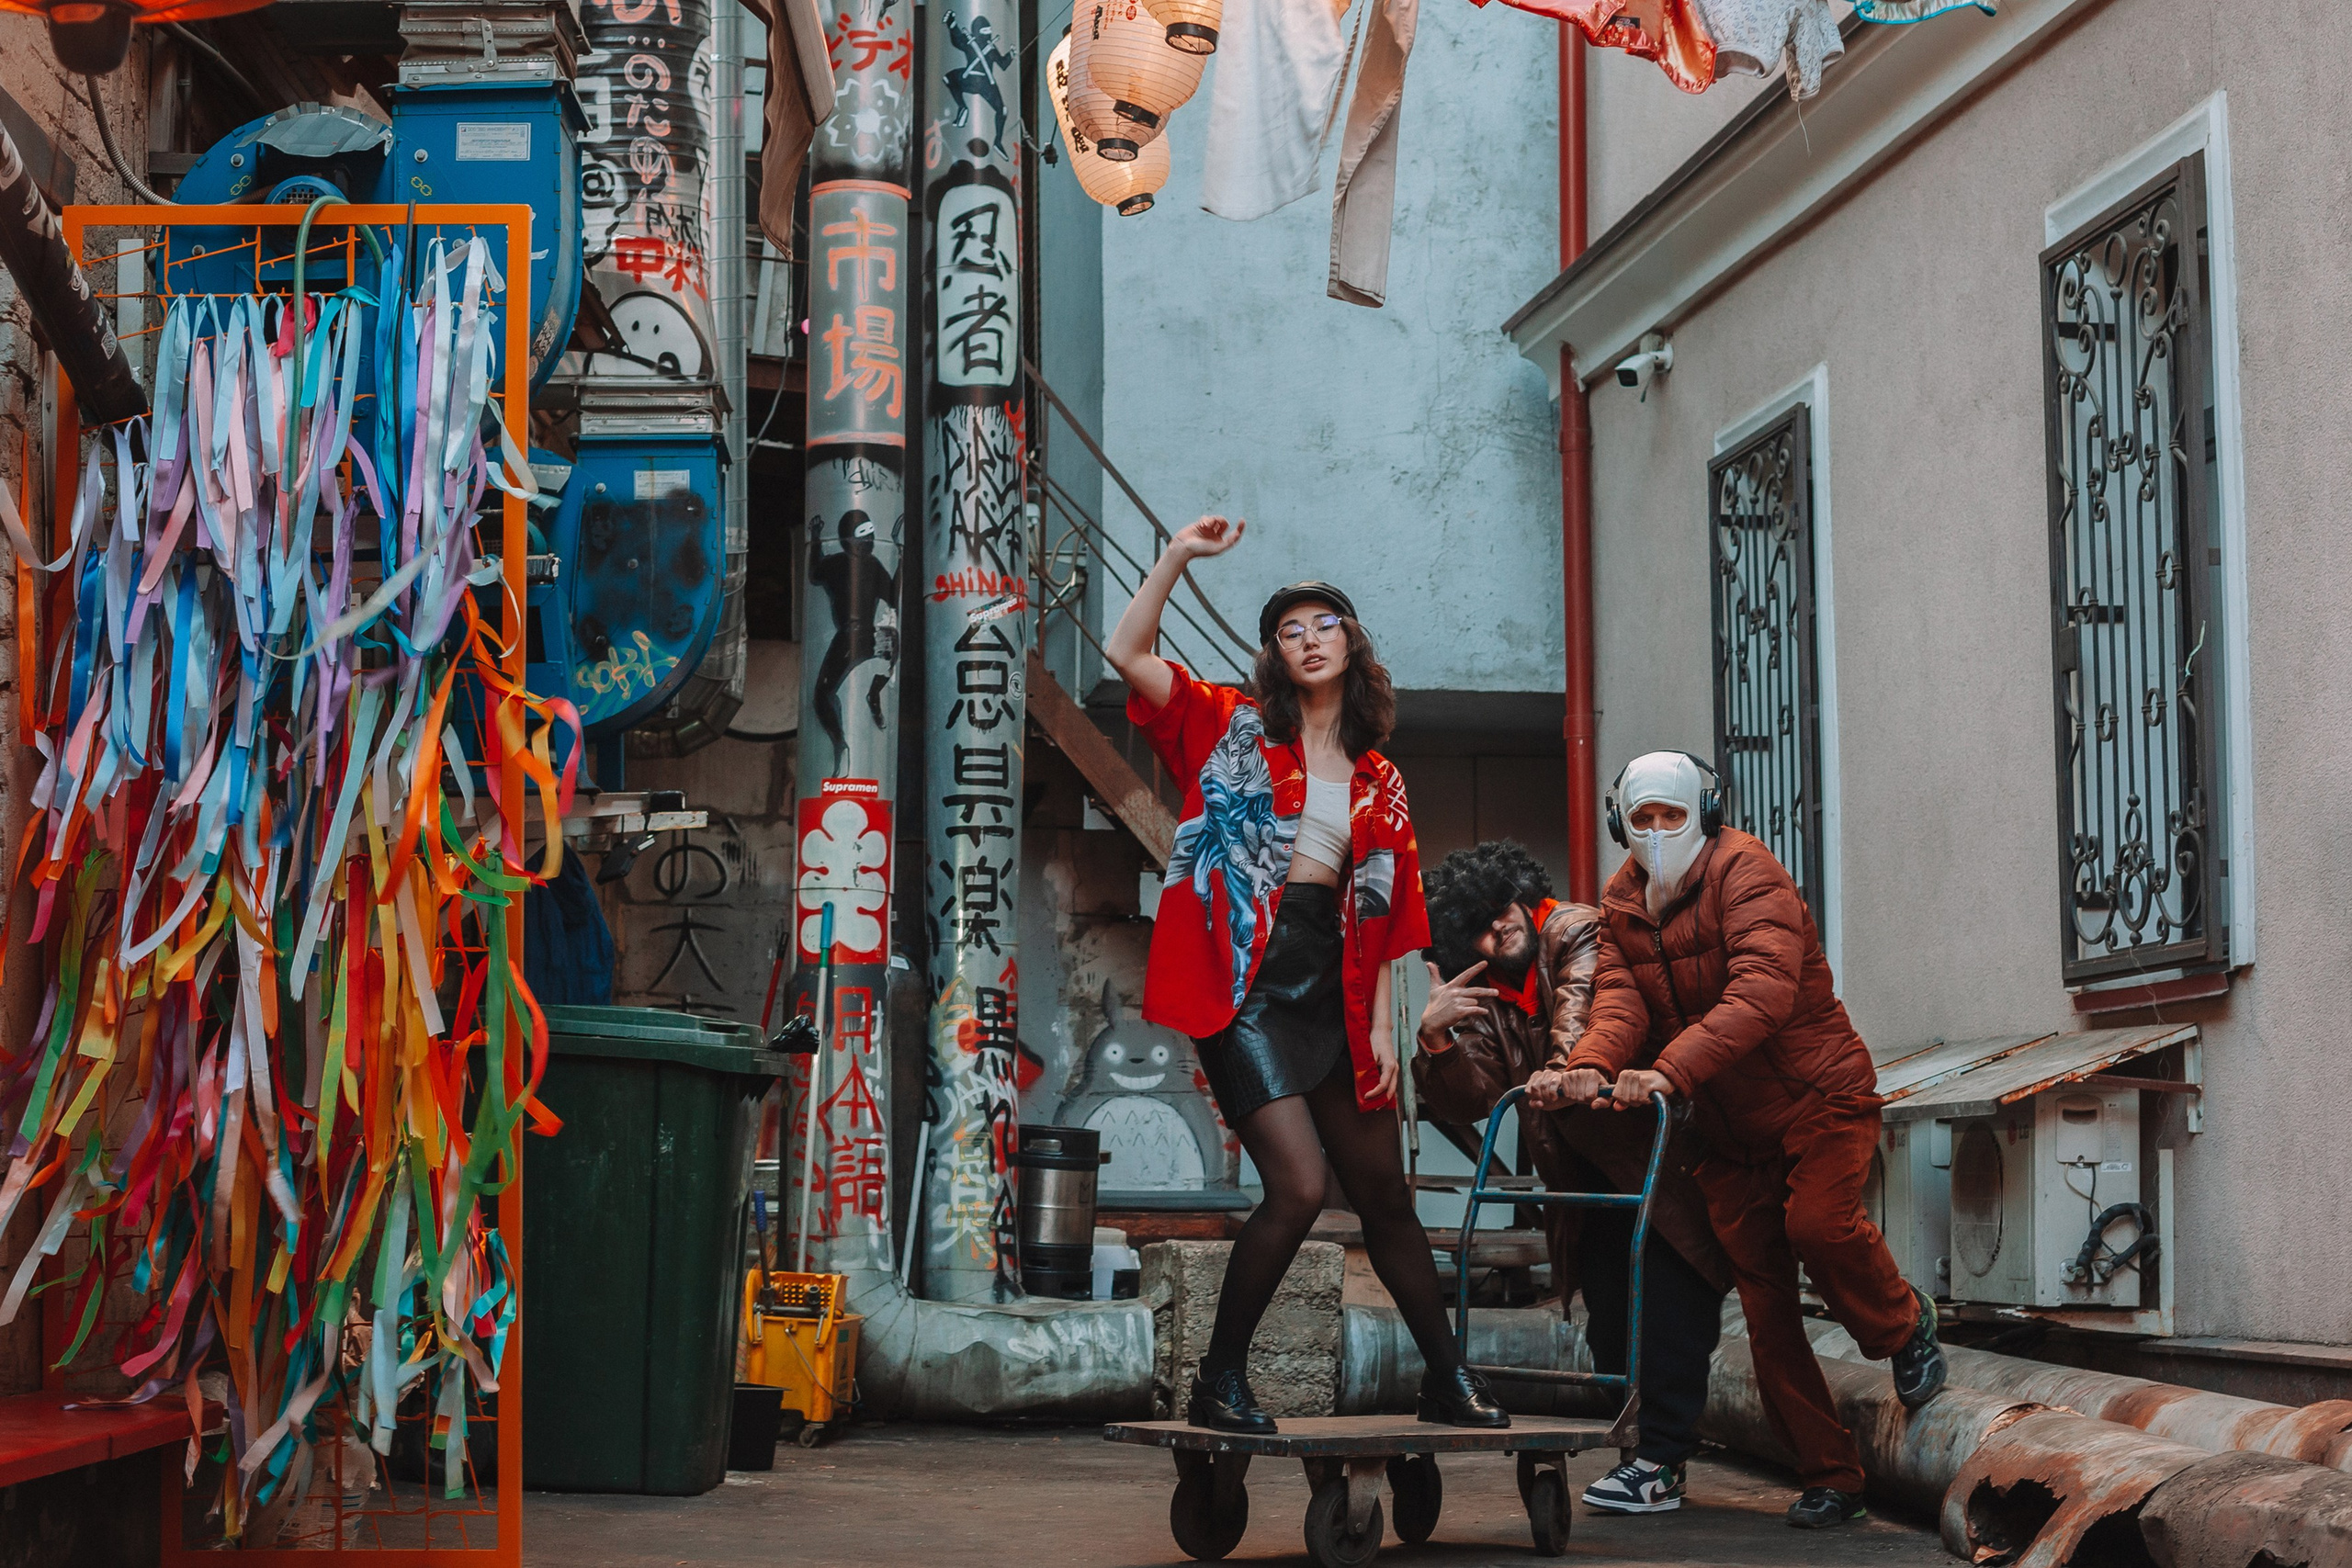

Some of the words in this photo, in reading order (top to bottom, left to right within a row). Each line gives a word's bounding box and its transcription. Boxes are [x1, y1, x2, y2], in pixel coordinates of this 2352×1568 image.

[821, 207, 902, 419] 市場
[942, 203, 1012, 376] 忍者
[822, 781, 878, 794] Supramen
[817, 986, 886, 1231] 日本語
